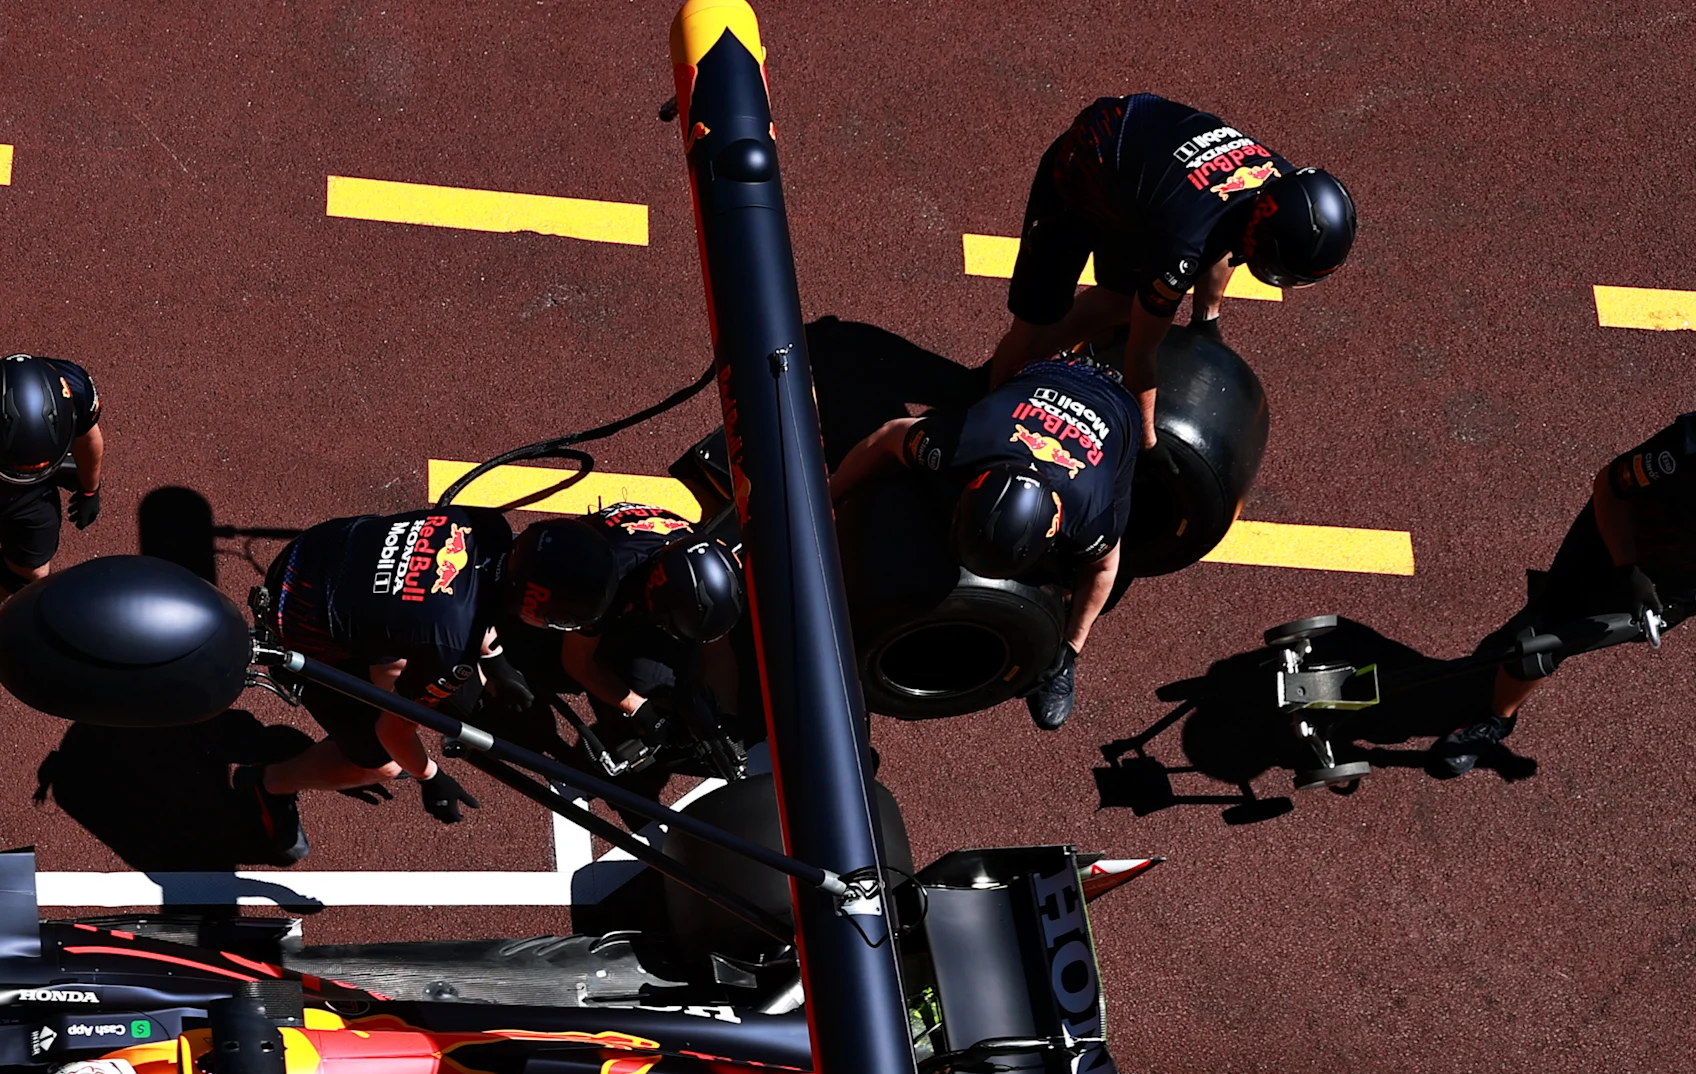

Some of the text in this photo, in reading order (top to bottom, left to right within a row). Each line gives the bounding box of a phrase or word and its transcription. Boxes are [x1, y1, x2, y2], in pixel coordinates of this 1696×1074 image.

[1192, 126, 1242, 150] Mobil
[1187, 144, 1273, 191] Red Bull
[1011, 402, 1105, 467] Red Bull
[1056, 394, 1111, 438] Mobil
[376, 522, 410, 571] Mobil
[392, 519, 425, 595] HONDA
[401, 515, 448, 602] Red Bull
[18, 988, 100, 1004] HONDA
[67, 1023, 126, 1037] Cash App
